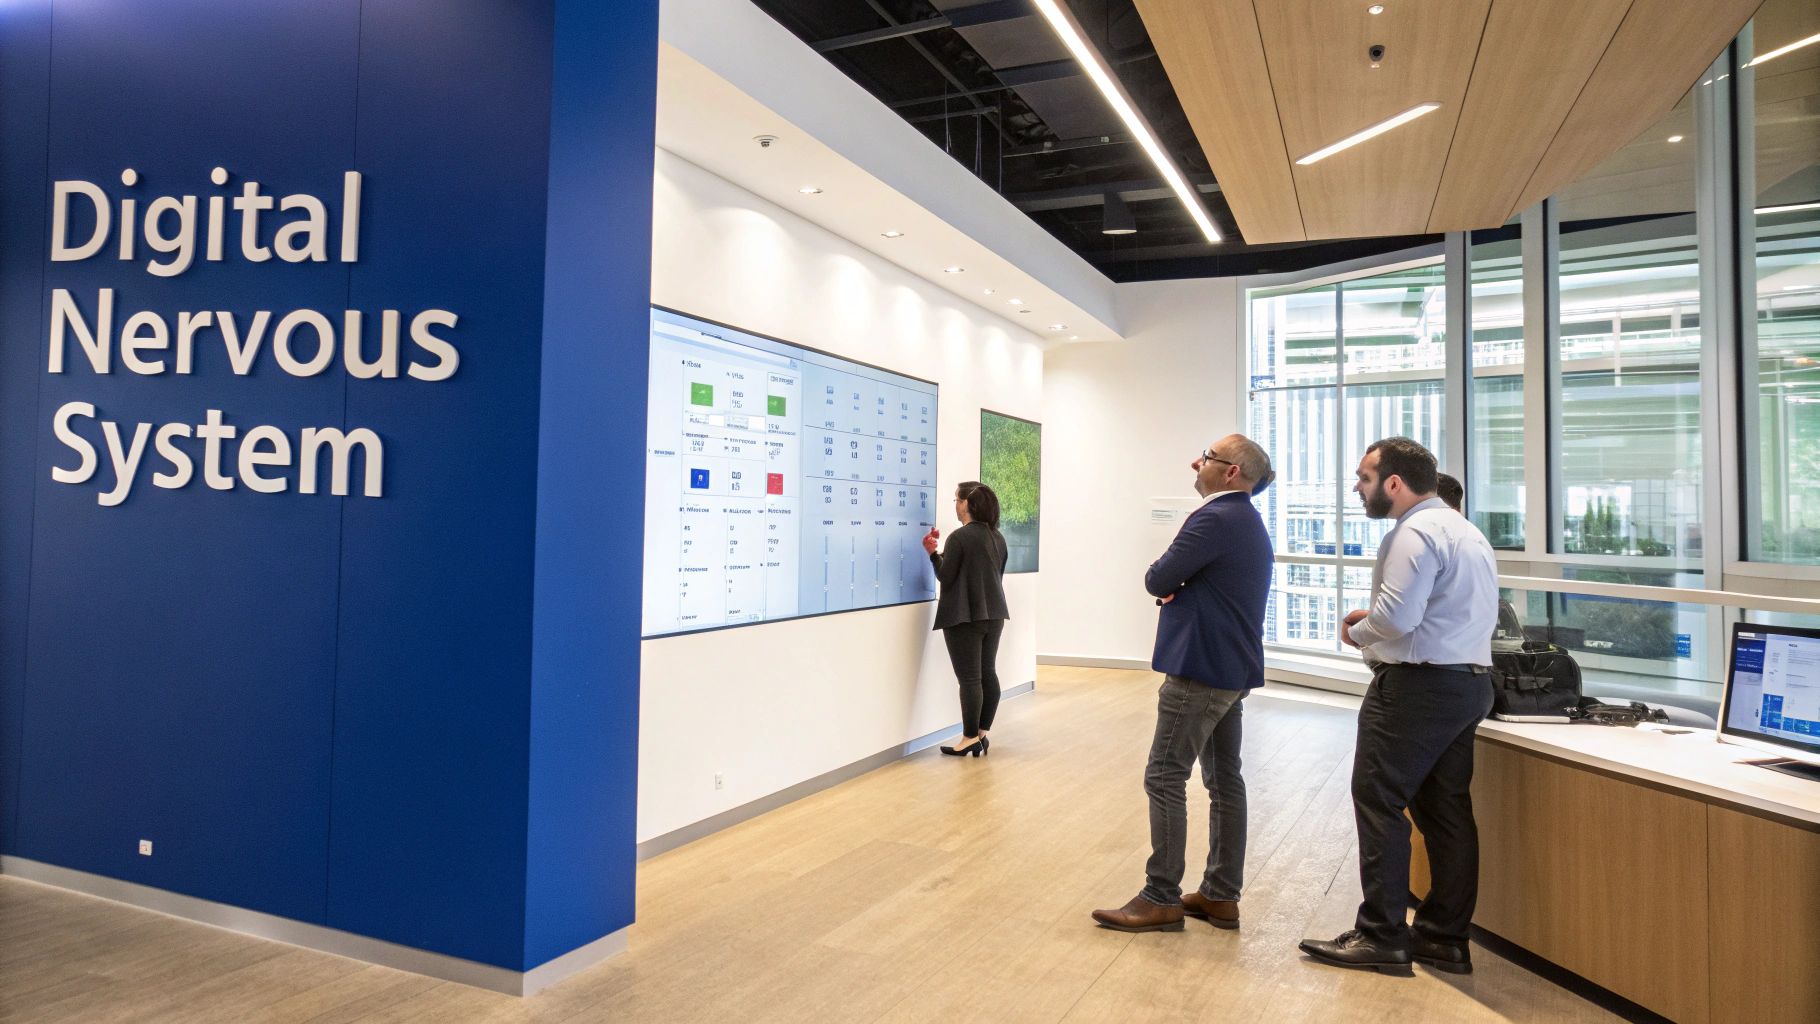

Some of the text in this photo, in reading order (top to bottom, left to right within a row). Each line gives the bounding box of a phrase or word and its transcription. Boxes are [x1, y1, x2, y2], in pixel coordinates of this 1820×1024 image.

[51, 167, 362, 276] Digital
[48, 288, 460, 381] Nervous
[52, 401, 384, 506] System
